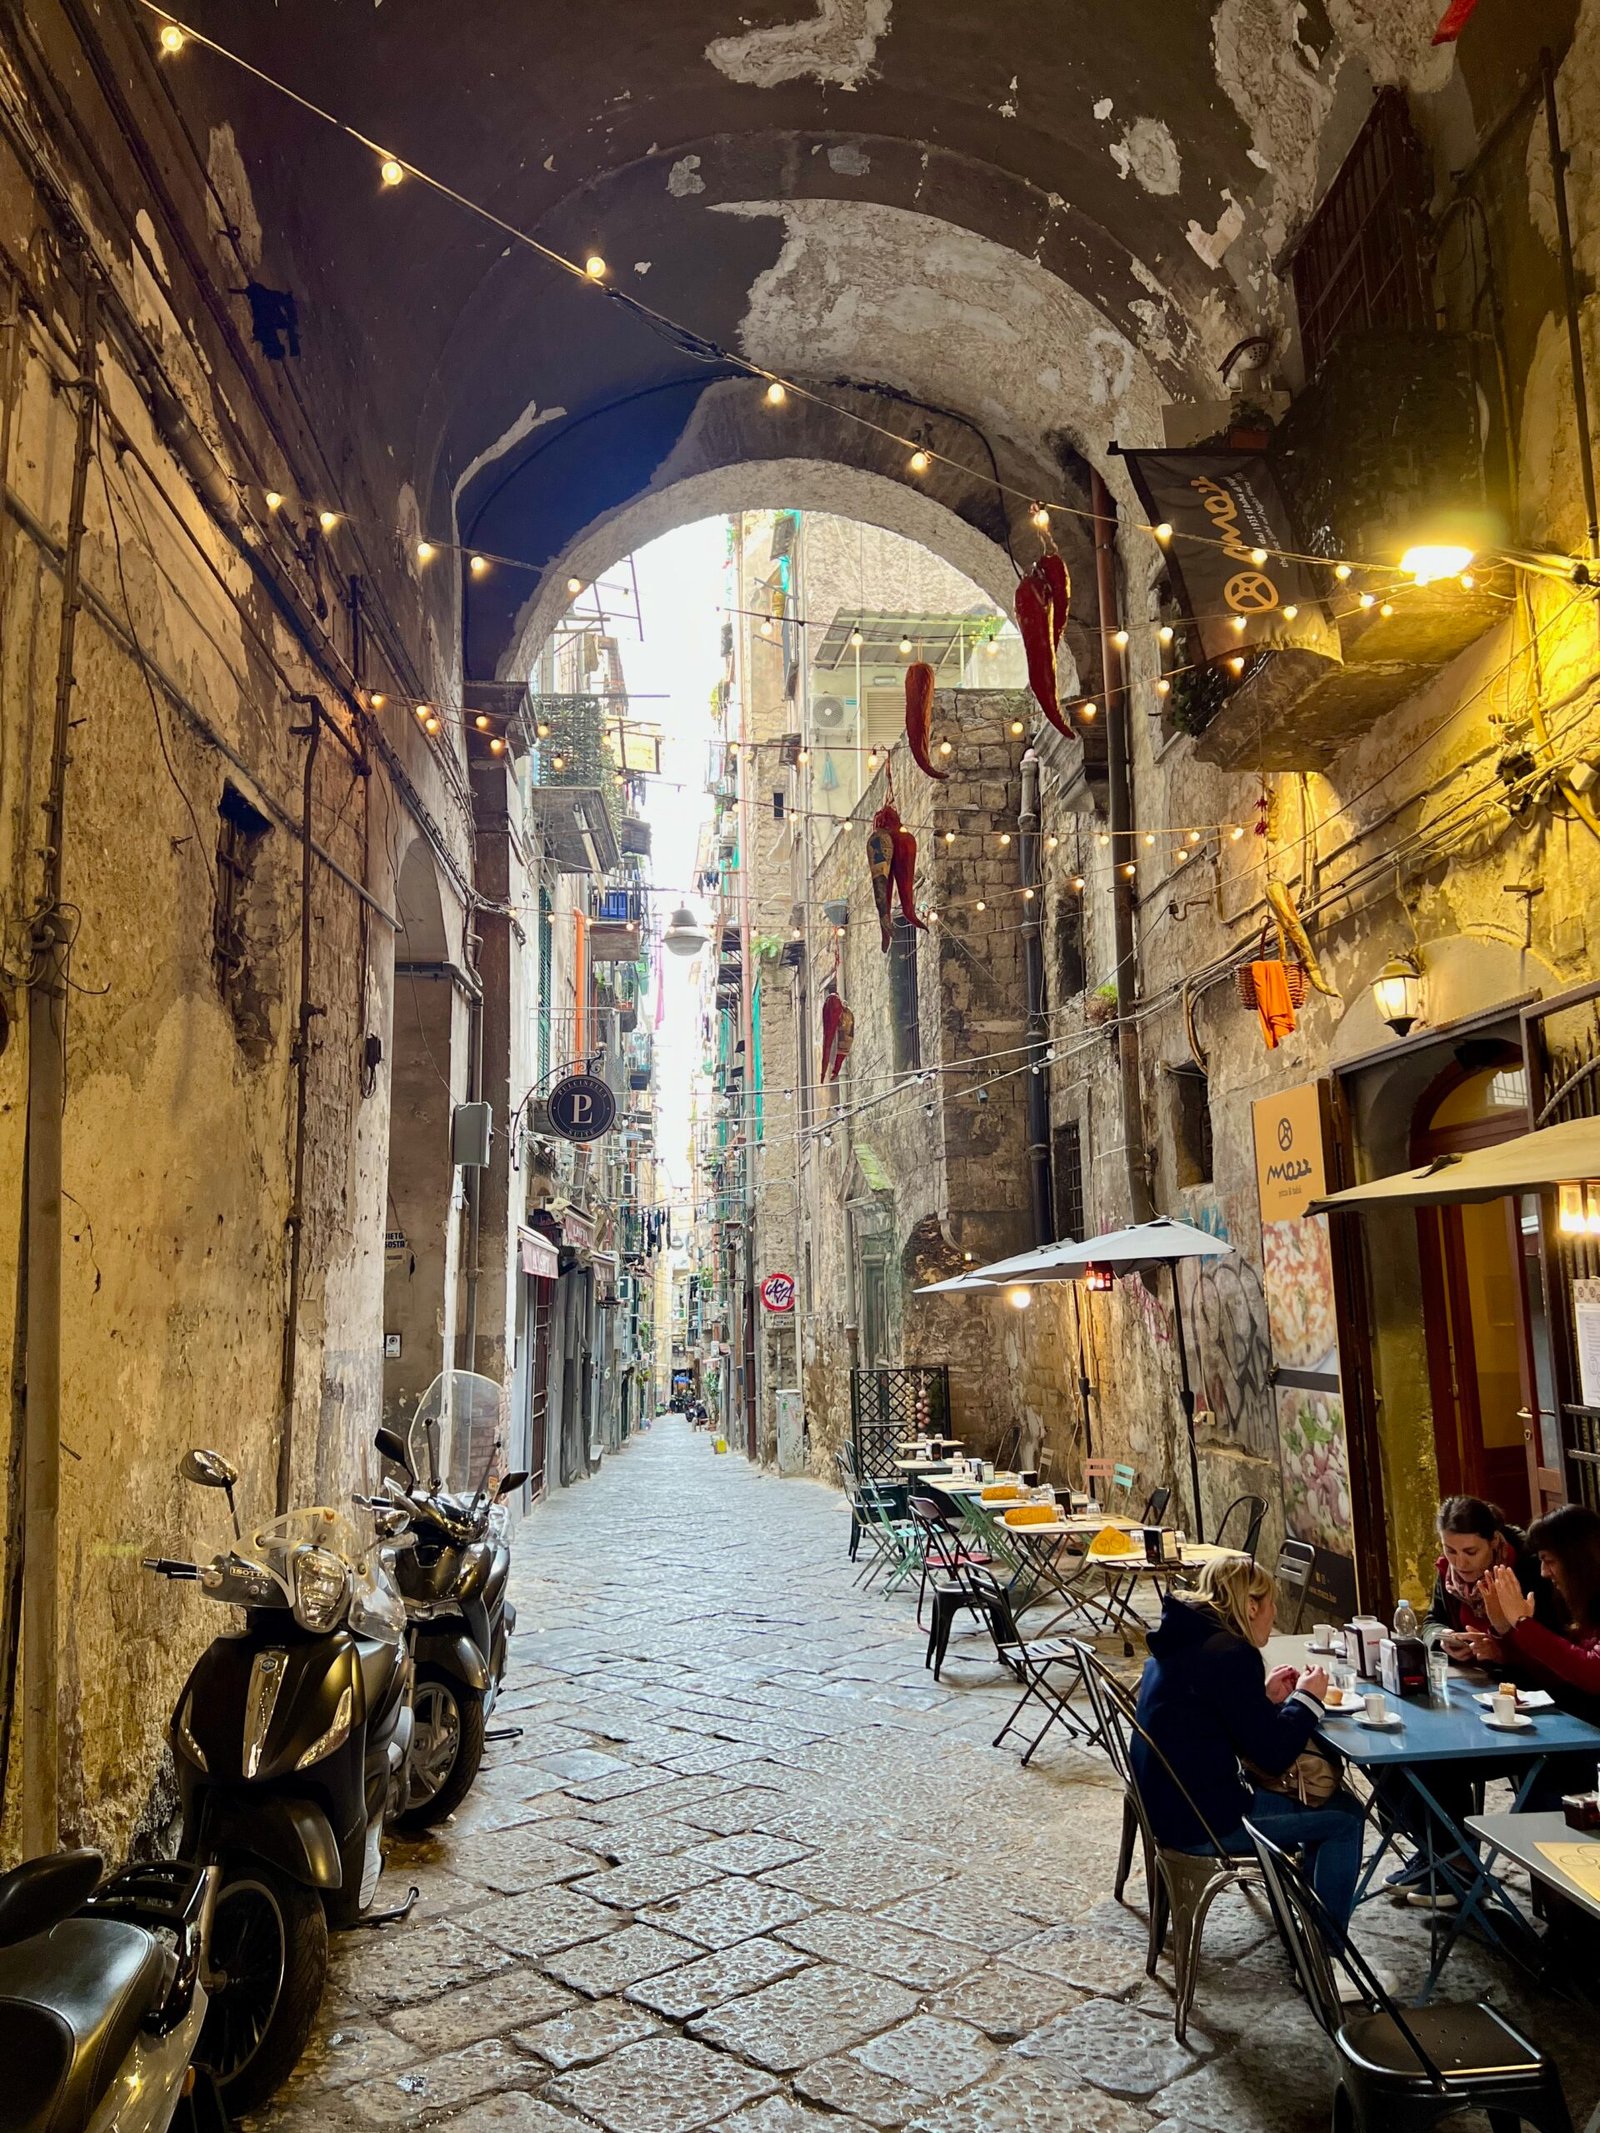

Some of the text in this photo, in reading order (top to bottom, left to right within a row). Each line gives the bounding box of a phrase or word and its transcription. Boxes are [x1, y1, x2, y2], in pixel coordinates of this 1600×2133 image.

[1246, 514, 1262, 531] 1935
[557, 1080, 607, 1098] PULCINELLA
[604, 1366, 611, 1380] 6
[231, 1567, 270, 1578] ISOTTA
